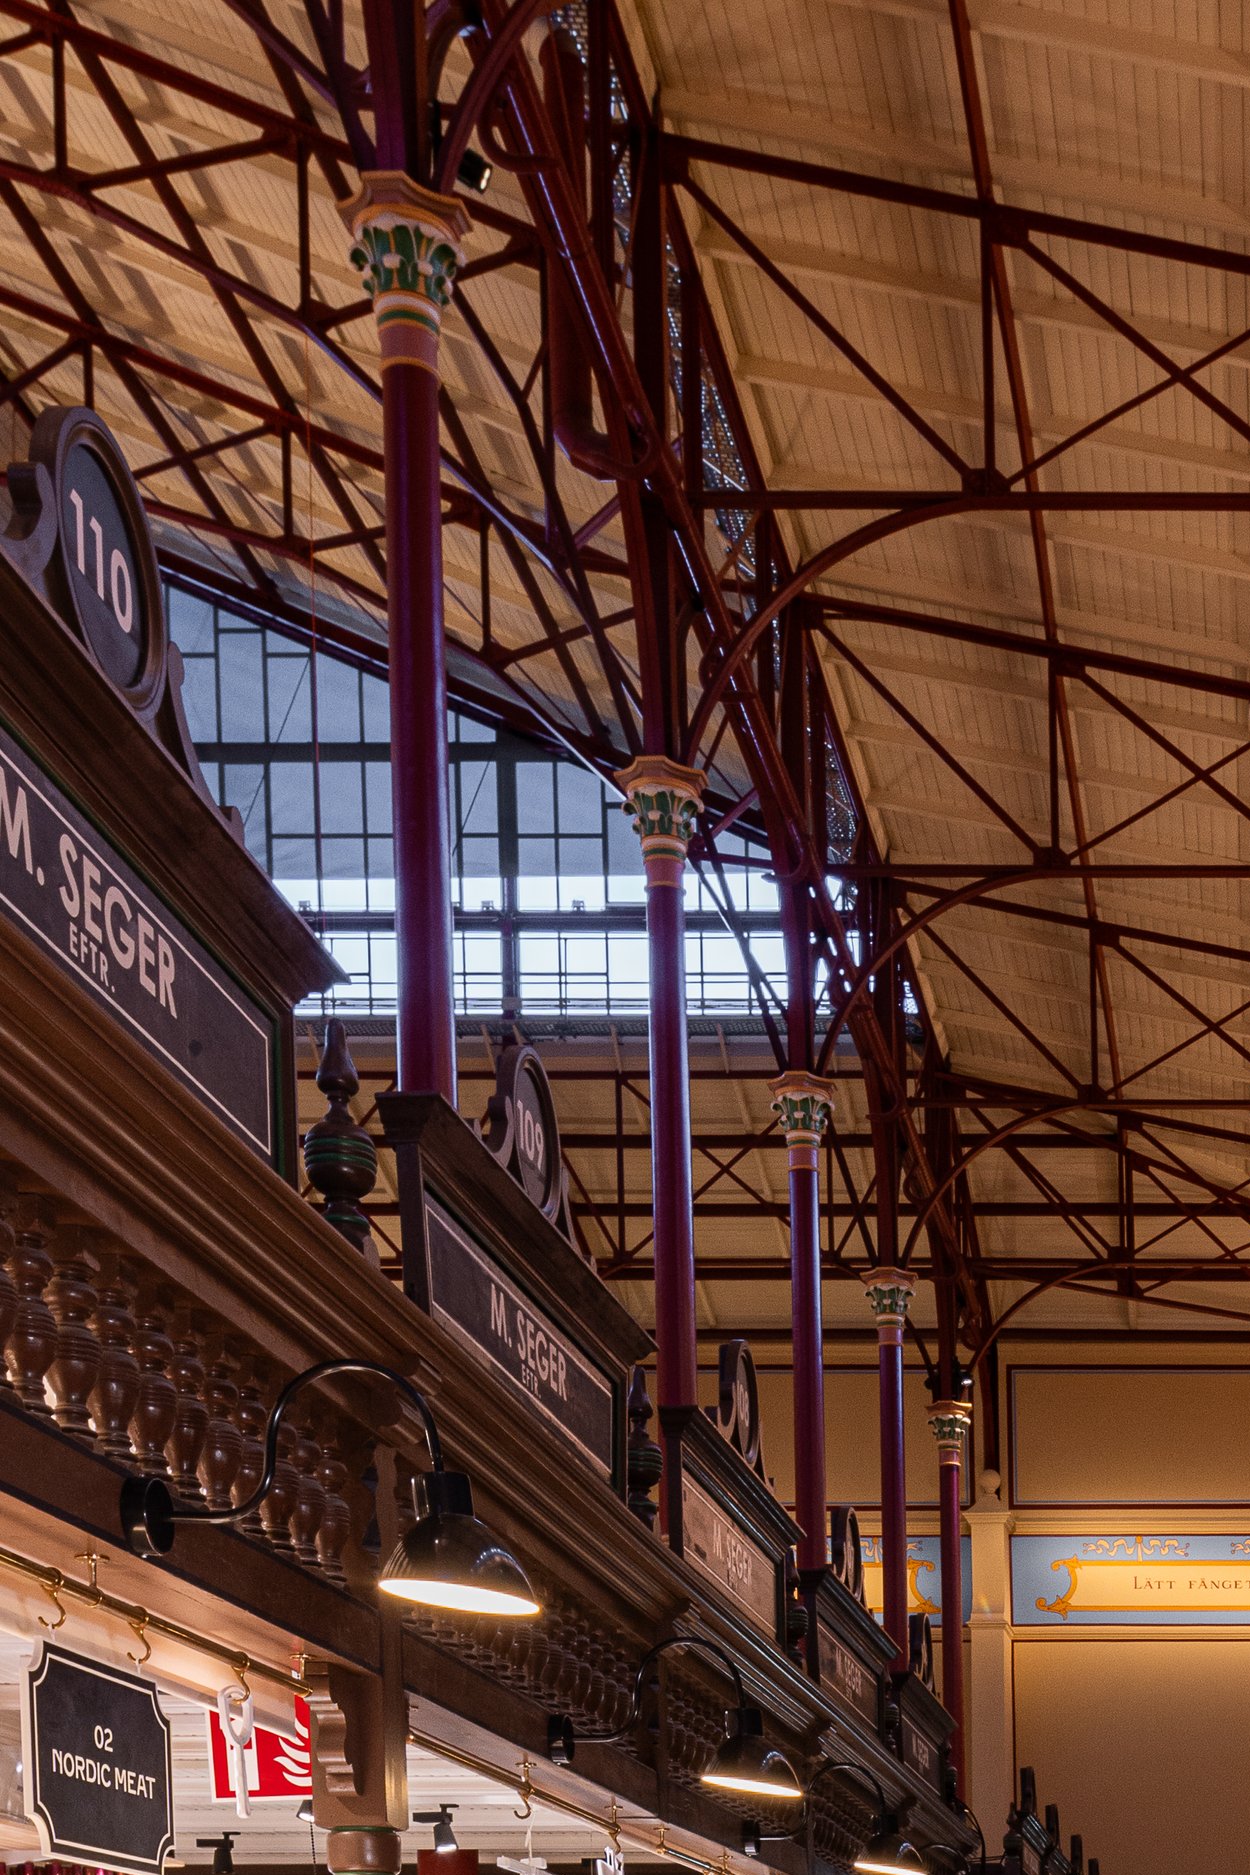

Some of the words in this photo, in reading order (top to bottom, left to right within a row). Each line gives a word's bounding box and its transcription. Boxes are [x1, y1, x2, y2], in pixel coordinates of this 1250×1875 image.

[70, 488, 133, 633] 110
[59, 834, 177, 1019] SEGER
[69, 922, 116, 993] EFTR.
[517, 1099, 544, 1173] 109
[491, 1283, 512, 1348] M.
[516, 1310, 568, 1401] SEGER
[727, 1535, 753, 1587] SEGER
[1133, 1575, 1176, 1590] LÄTT
[52, 1748, 112, 1787] NORDIC
[114, 1767, 156, 1799] MEAT
[94, 1725, 114, 1752] 02
